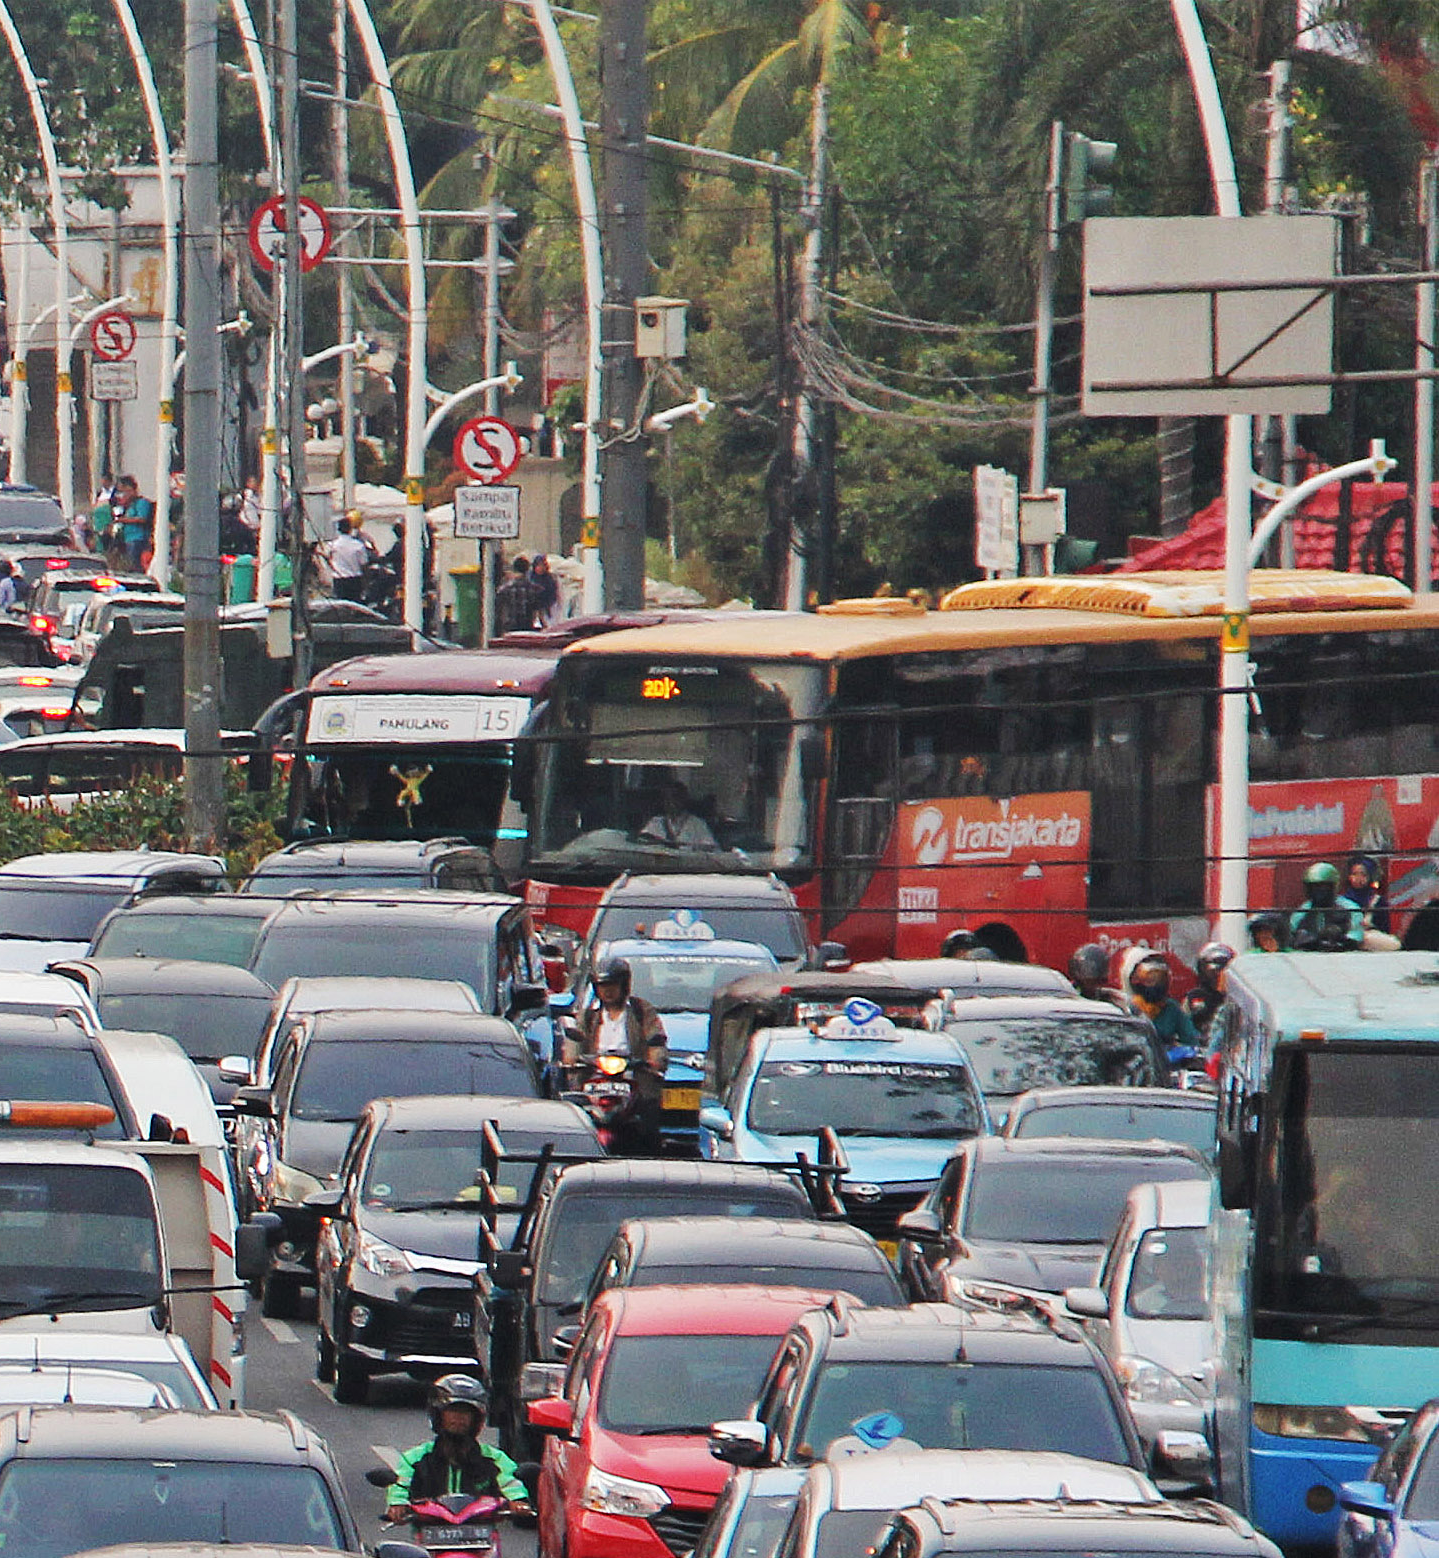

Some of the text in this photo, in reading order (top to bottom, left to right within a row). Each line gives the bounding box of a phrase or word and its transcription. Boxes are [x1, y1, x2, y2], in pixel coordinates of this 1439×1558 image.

[380, 710, 510, 732] PAMULANG 15
[955, 812, 1082, 850] transjakarta
[841, 1027, 886, 1037] TAKSI
[826, 1062, 949, 1077] Bluebird Group
